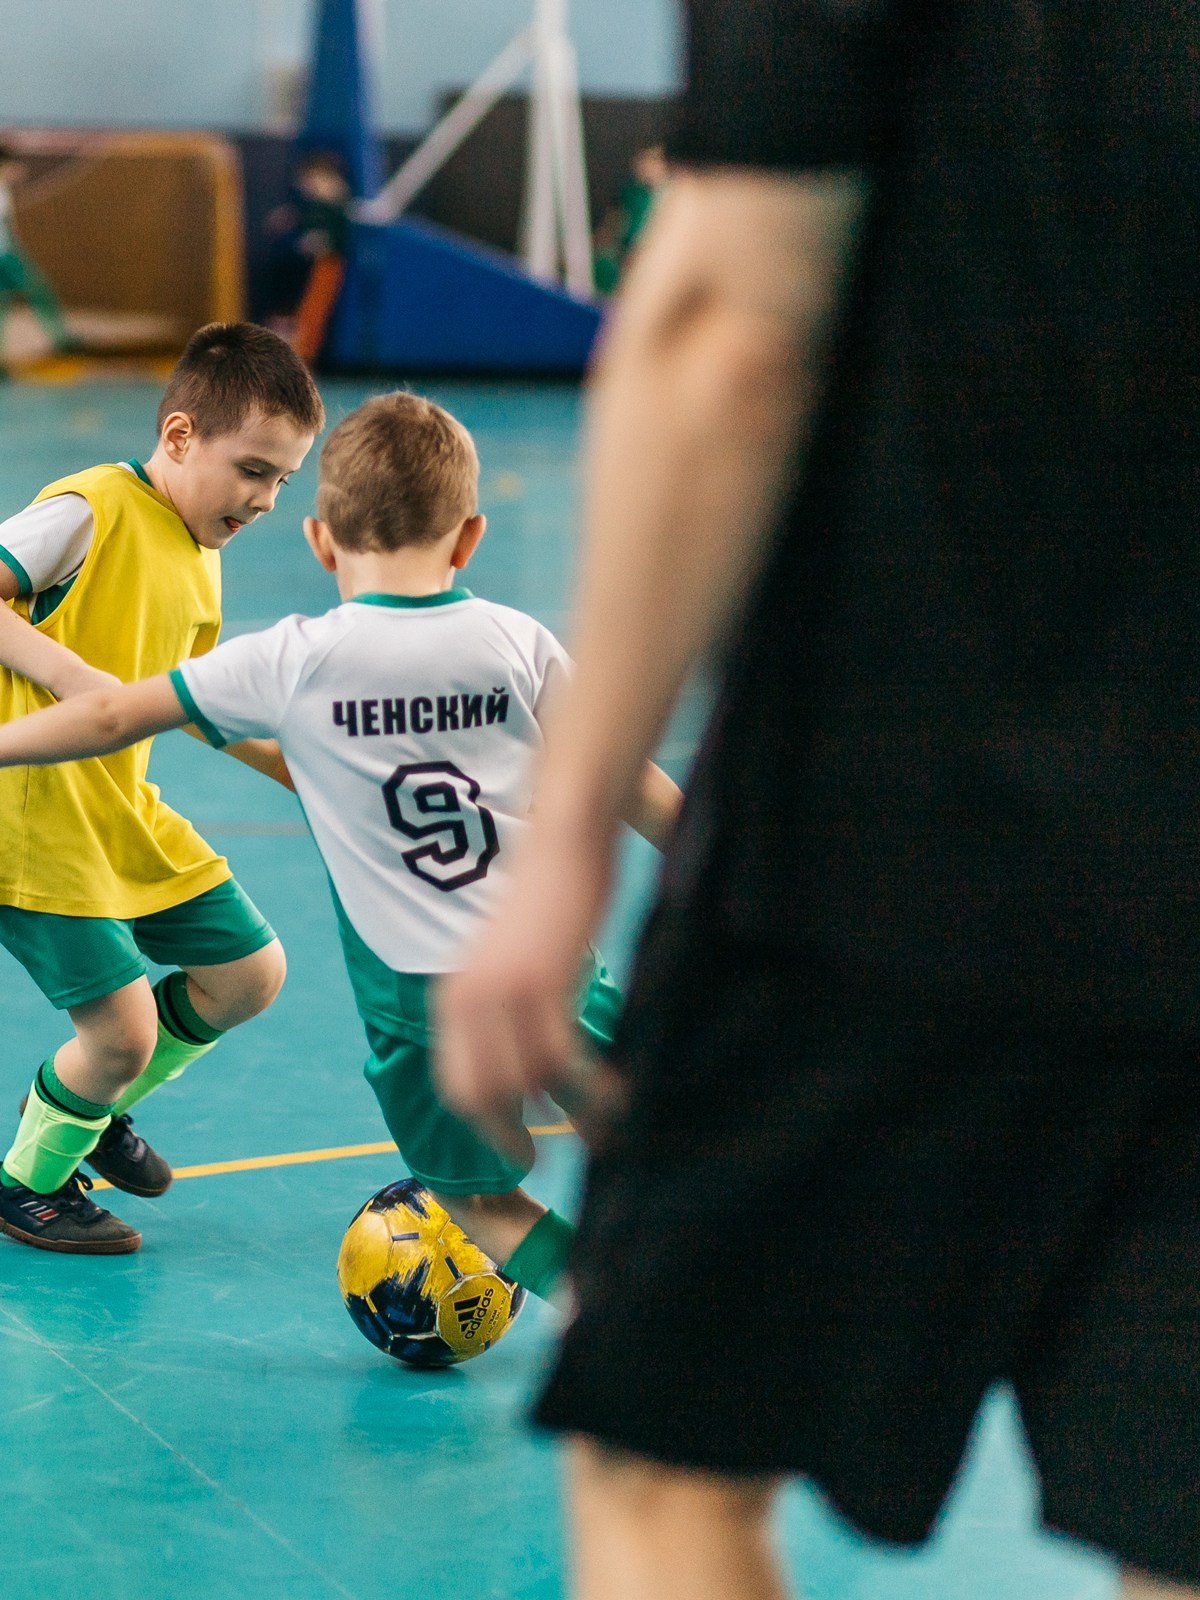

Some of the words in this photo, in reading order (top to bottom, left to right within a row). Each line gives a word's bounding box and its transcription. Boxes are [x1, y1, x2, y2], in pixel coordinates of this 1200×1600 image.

[332, 686, 510, 737] ЧЕНСКИЙ
[381, 760, 501, 892] 9
[465, 1288, 494, 1339] adidas
